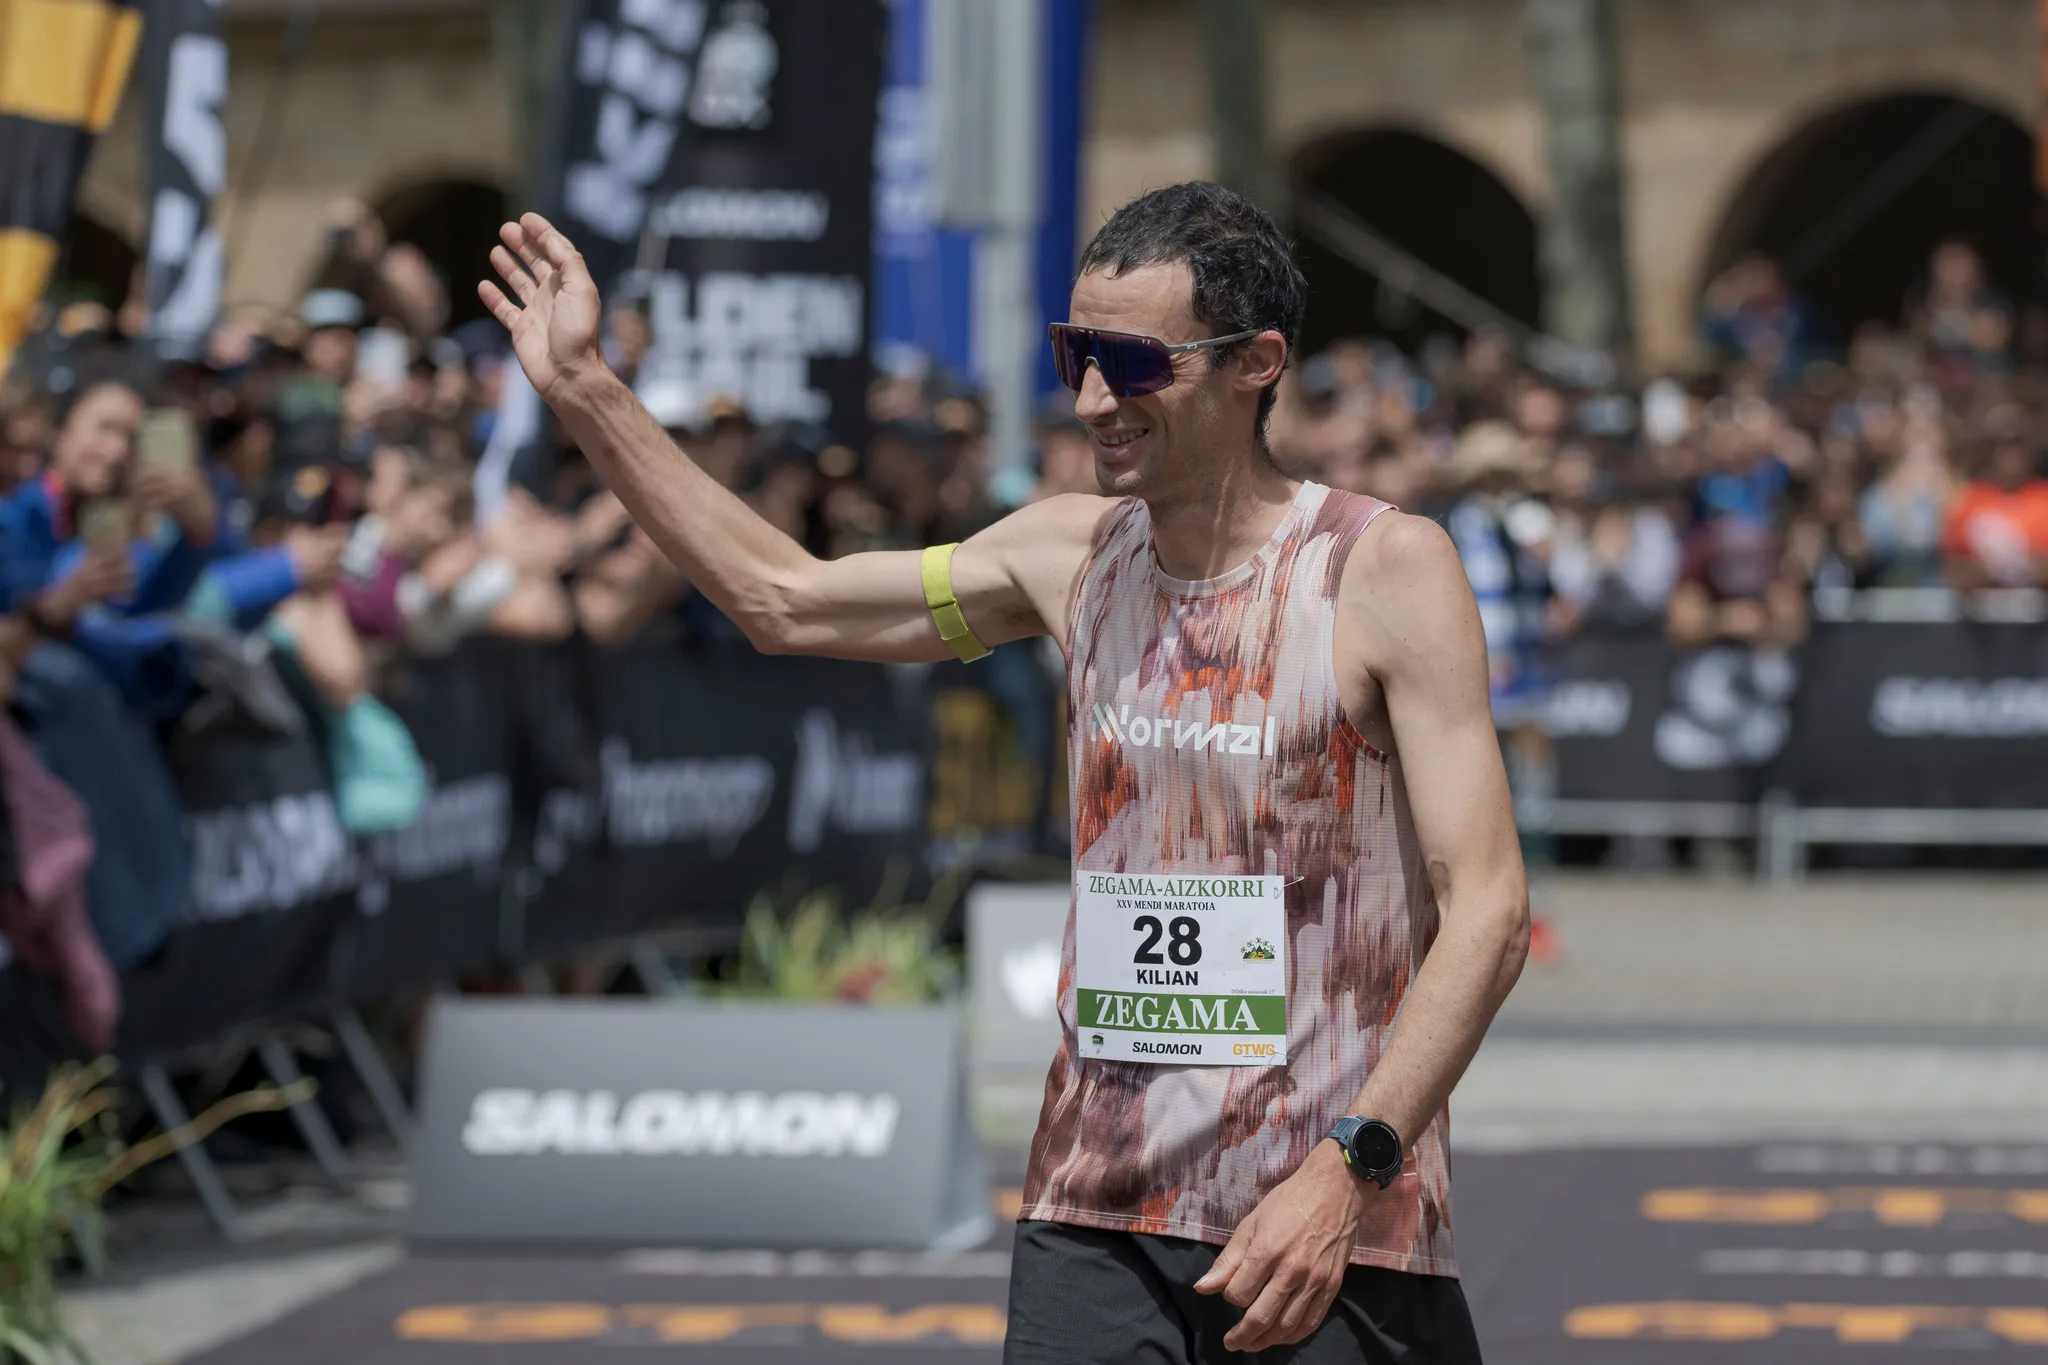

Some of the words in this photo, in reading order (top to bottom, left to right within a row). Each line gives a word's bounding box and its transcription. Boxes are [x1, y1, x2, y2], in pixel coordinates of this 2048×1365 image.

[1089, 875, 1264, 898] ZEGAMA-AIZKORRI
[1116, 899, 1132, 909] XXV
[1134, 900, 1162, 910] MENDI
[1164, 901, 1216, 911] MARATOIA
[1133, 915, 1202, 966] 28
[1136, 969, 1199, 986] KILIAN
[1095, 993, 1260, 1031] ZEGAMA
[1132, 1042, 1202, 1055] SALOMON
[1232, 1043, 1276, 1056] GTWS
[462, 1089, 898, 1158] SALOMON
